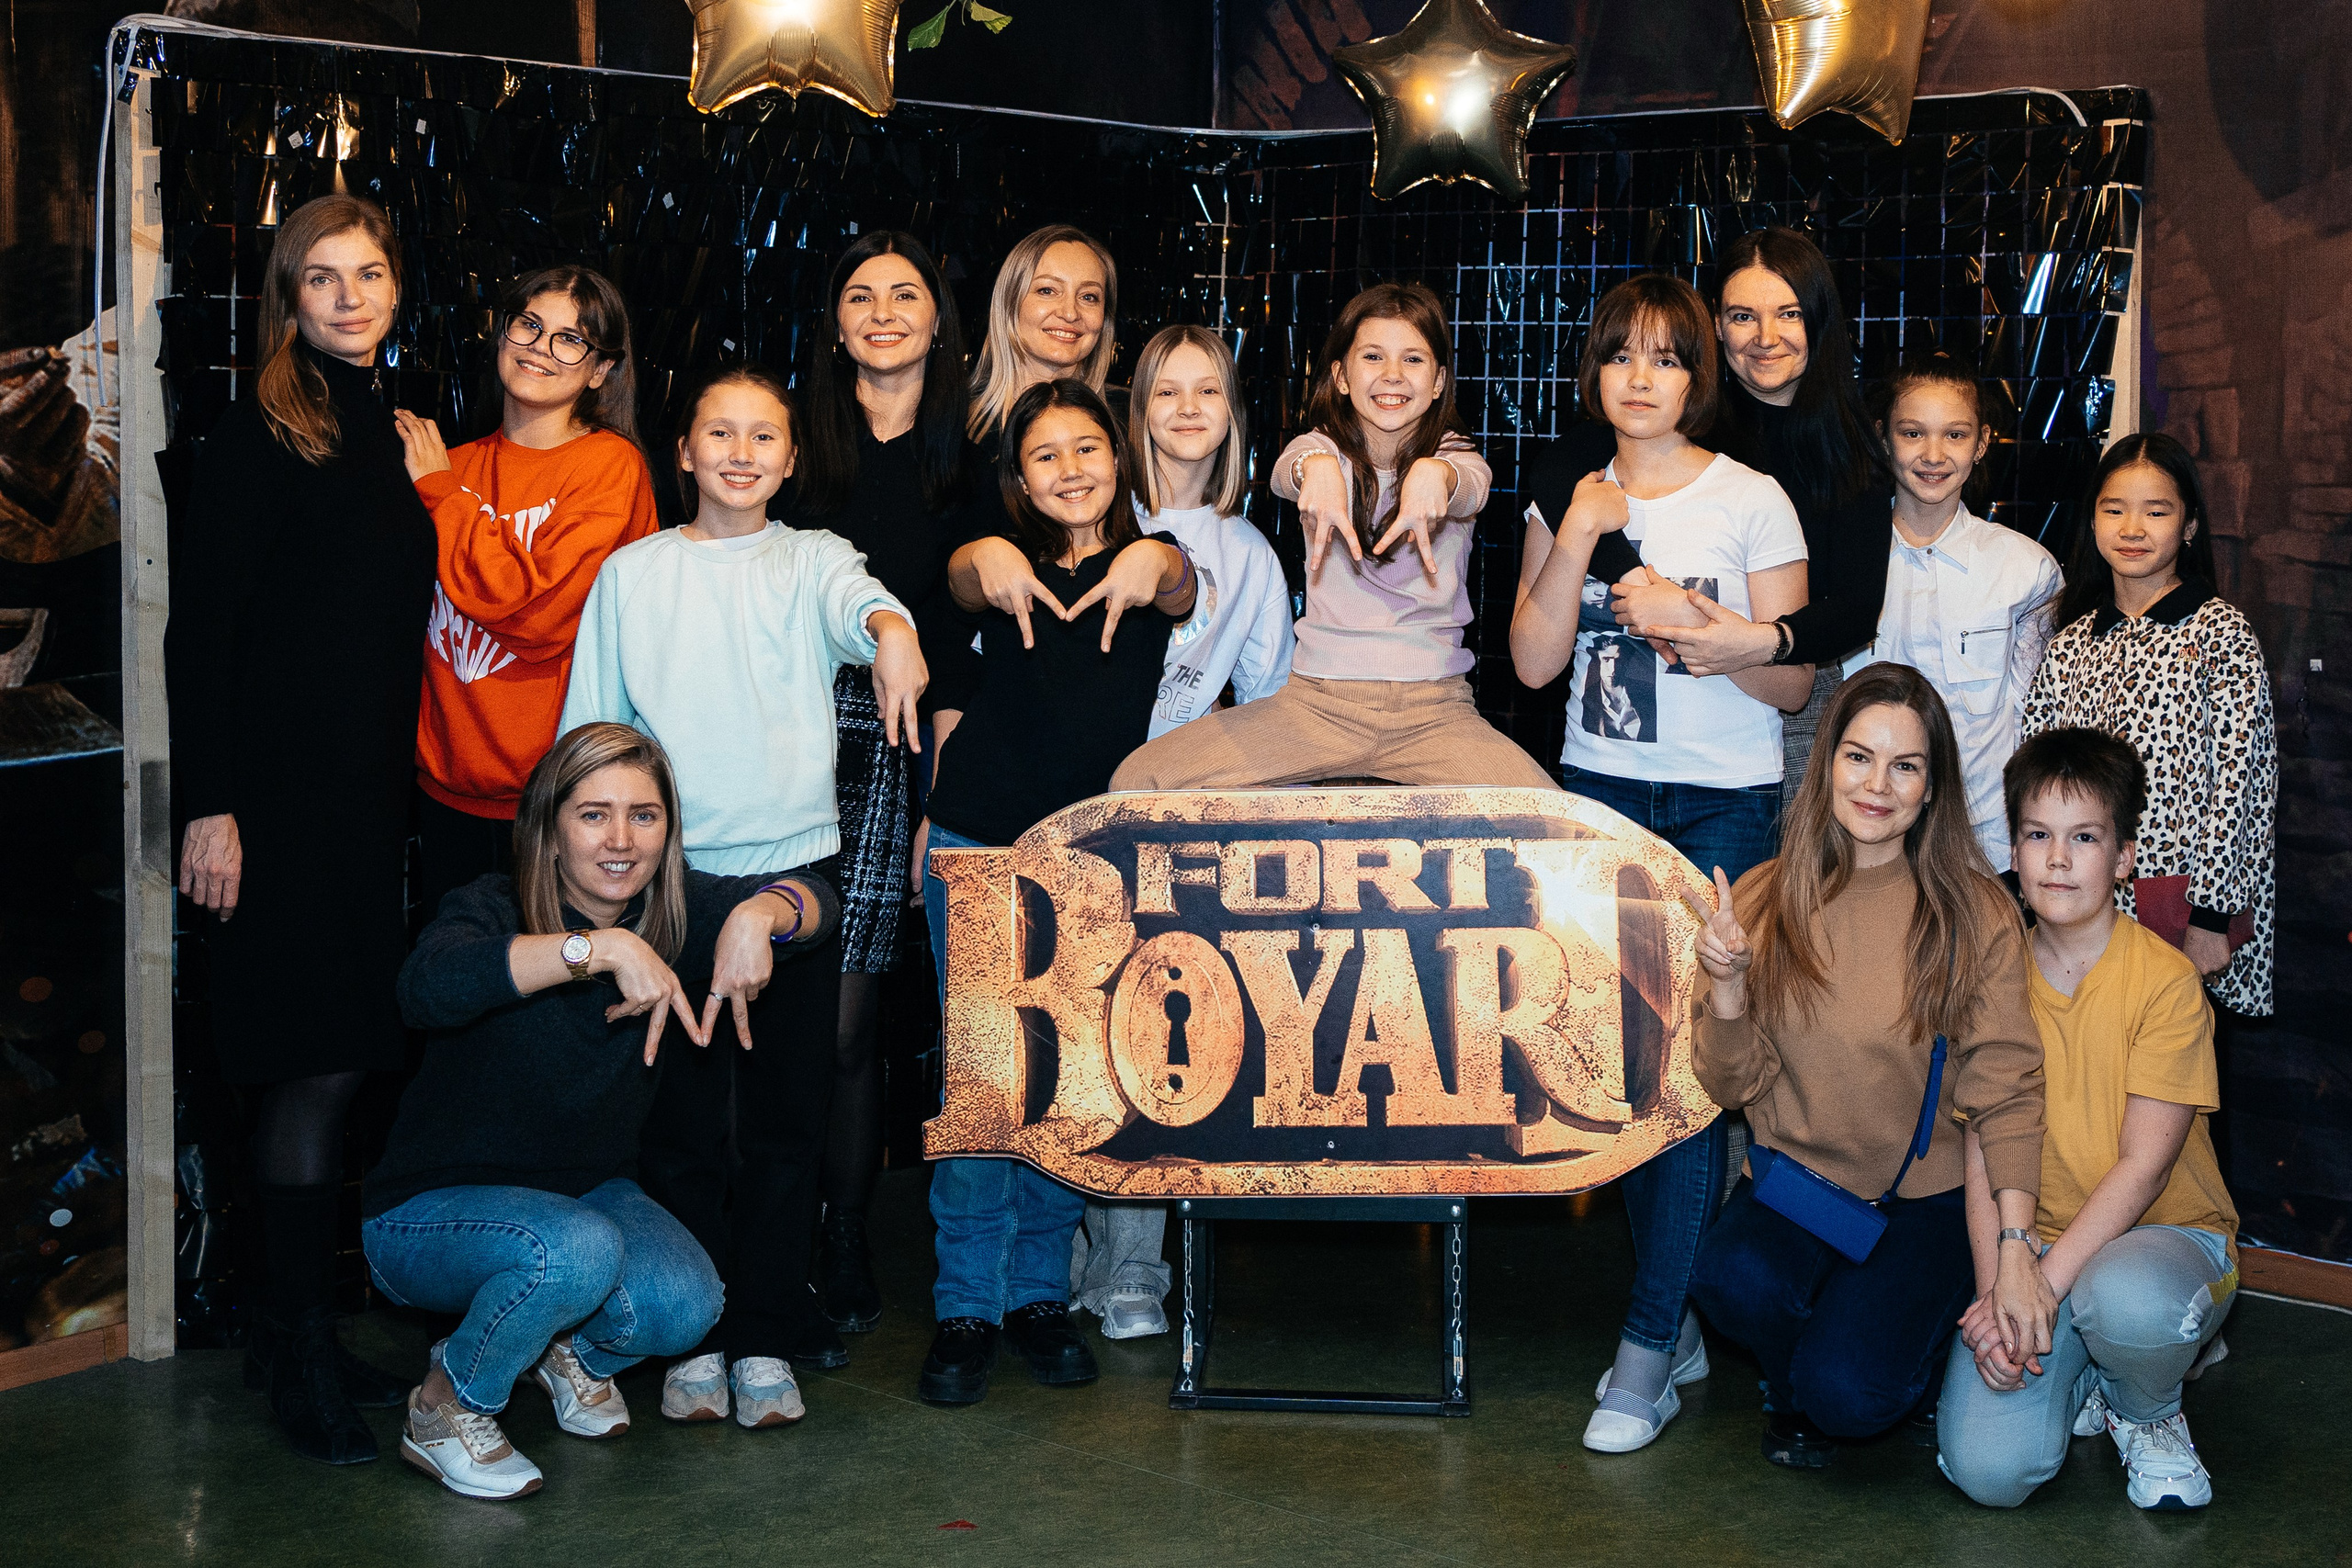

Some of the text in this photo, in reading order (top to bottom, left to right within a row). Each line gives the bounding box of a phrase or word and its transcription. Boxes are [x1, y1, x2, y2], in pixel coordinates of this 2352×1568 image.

[1171, 663, 1204, 690] THE
[1135, 837, 1519, 916] FORT
[922, 834, 1721, 1159] BOYARD
